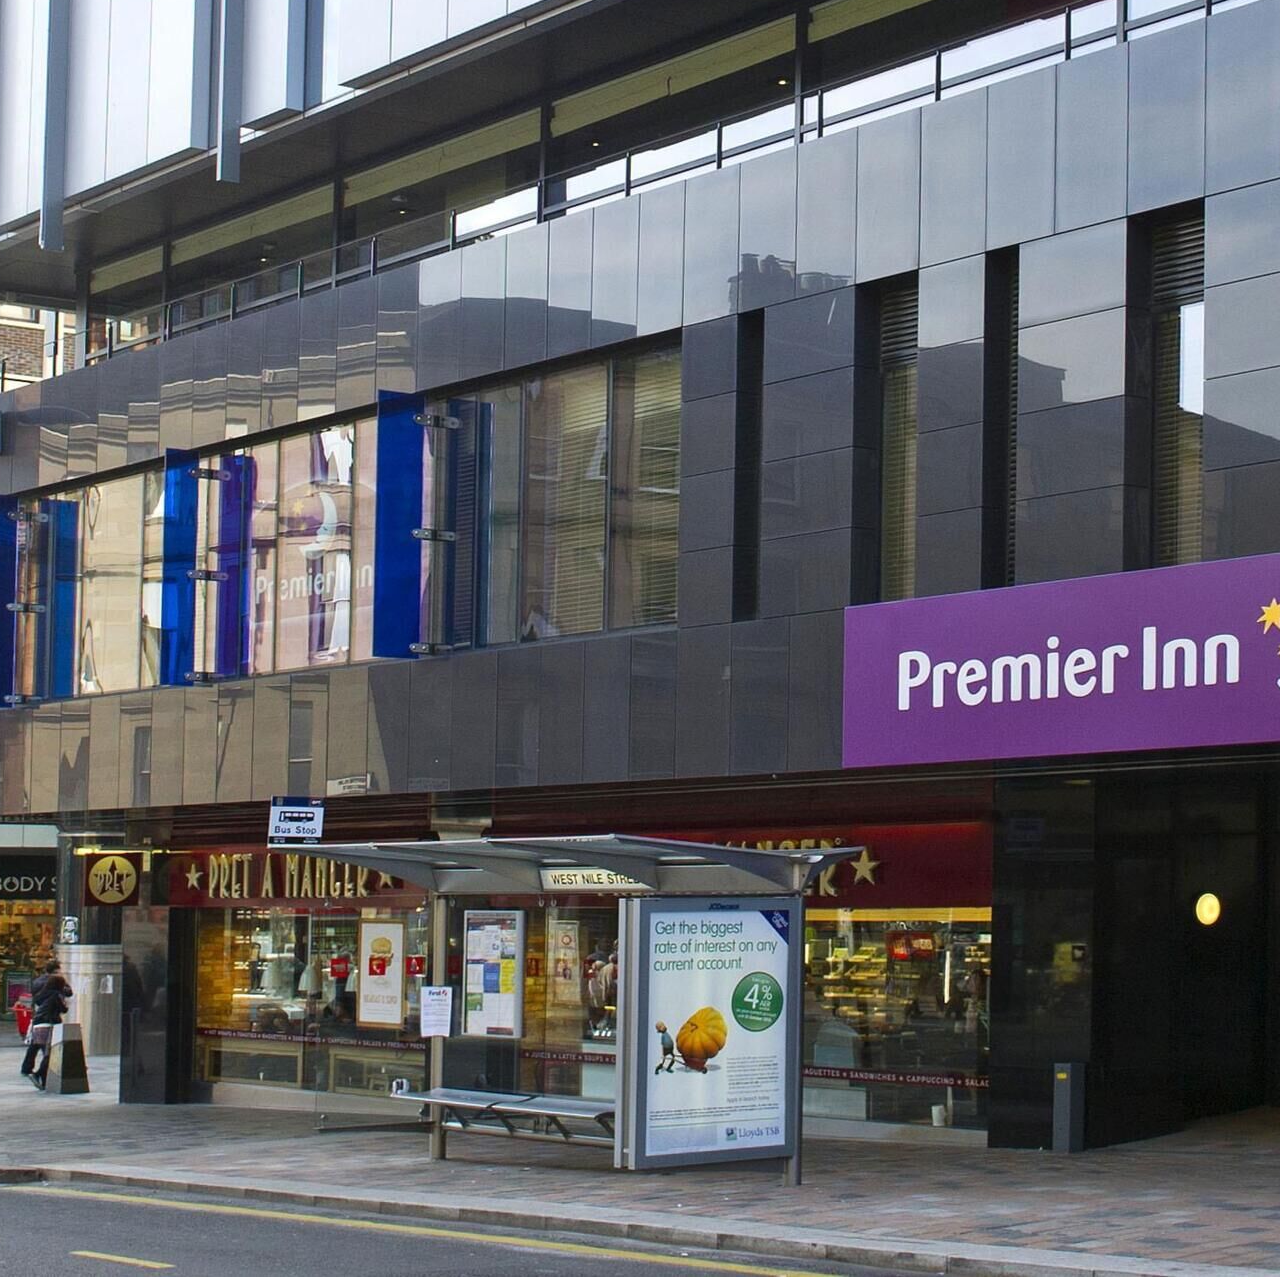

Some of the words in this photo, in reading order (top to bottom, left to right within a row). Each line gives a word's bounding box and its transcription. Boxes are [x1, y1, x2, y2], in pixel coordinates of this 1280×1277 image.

[255, 567, 335, 605] Premier
[896, 635, 1129, 712] Premier
[1141, 625, 1241, 691] Inn
[274, 825, 291, 834] Bus
[295, 825, 317, 835] Stop
[96, 870, 130, 891] PRET
[208, 852, 253, 899] PRET
[285, 853, 369, 899] MANGER
[550, 873, 579, 885] WEST
[581, 873, 604, 885] NILE
[606, 873, 641, 884] STRE
[654, 920, 676, 935] Get
[679, 920, 698, 935] the
[700, 920, 743, 938] biggest
[654, 940, 678, 954] rate
[680, 939, 693, 954] of
[694, 939, 736, 953] interest
[738, 941, 754, 953] on
[756, 940, 778, 955] any
[653, 958, 694, 972] current
[696, 957, 743, 971] account.
[558, 1052, 577, 1060] LATTE
[803, 1068, 841, 1077] AGUETTES
[849, 1071, 897, 1082] SANDWICHES
[906, 1074, 955, 1085] CAPPUCCINO
[738, 1127, 764, 1139] Lloyds
[764, 1126, 780, 1137] TSB
